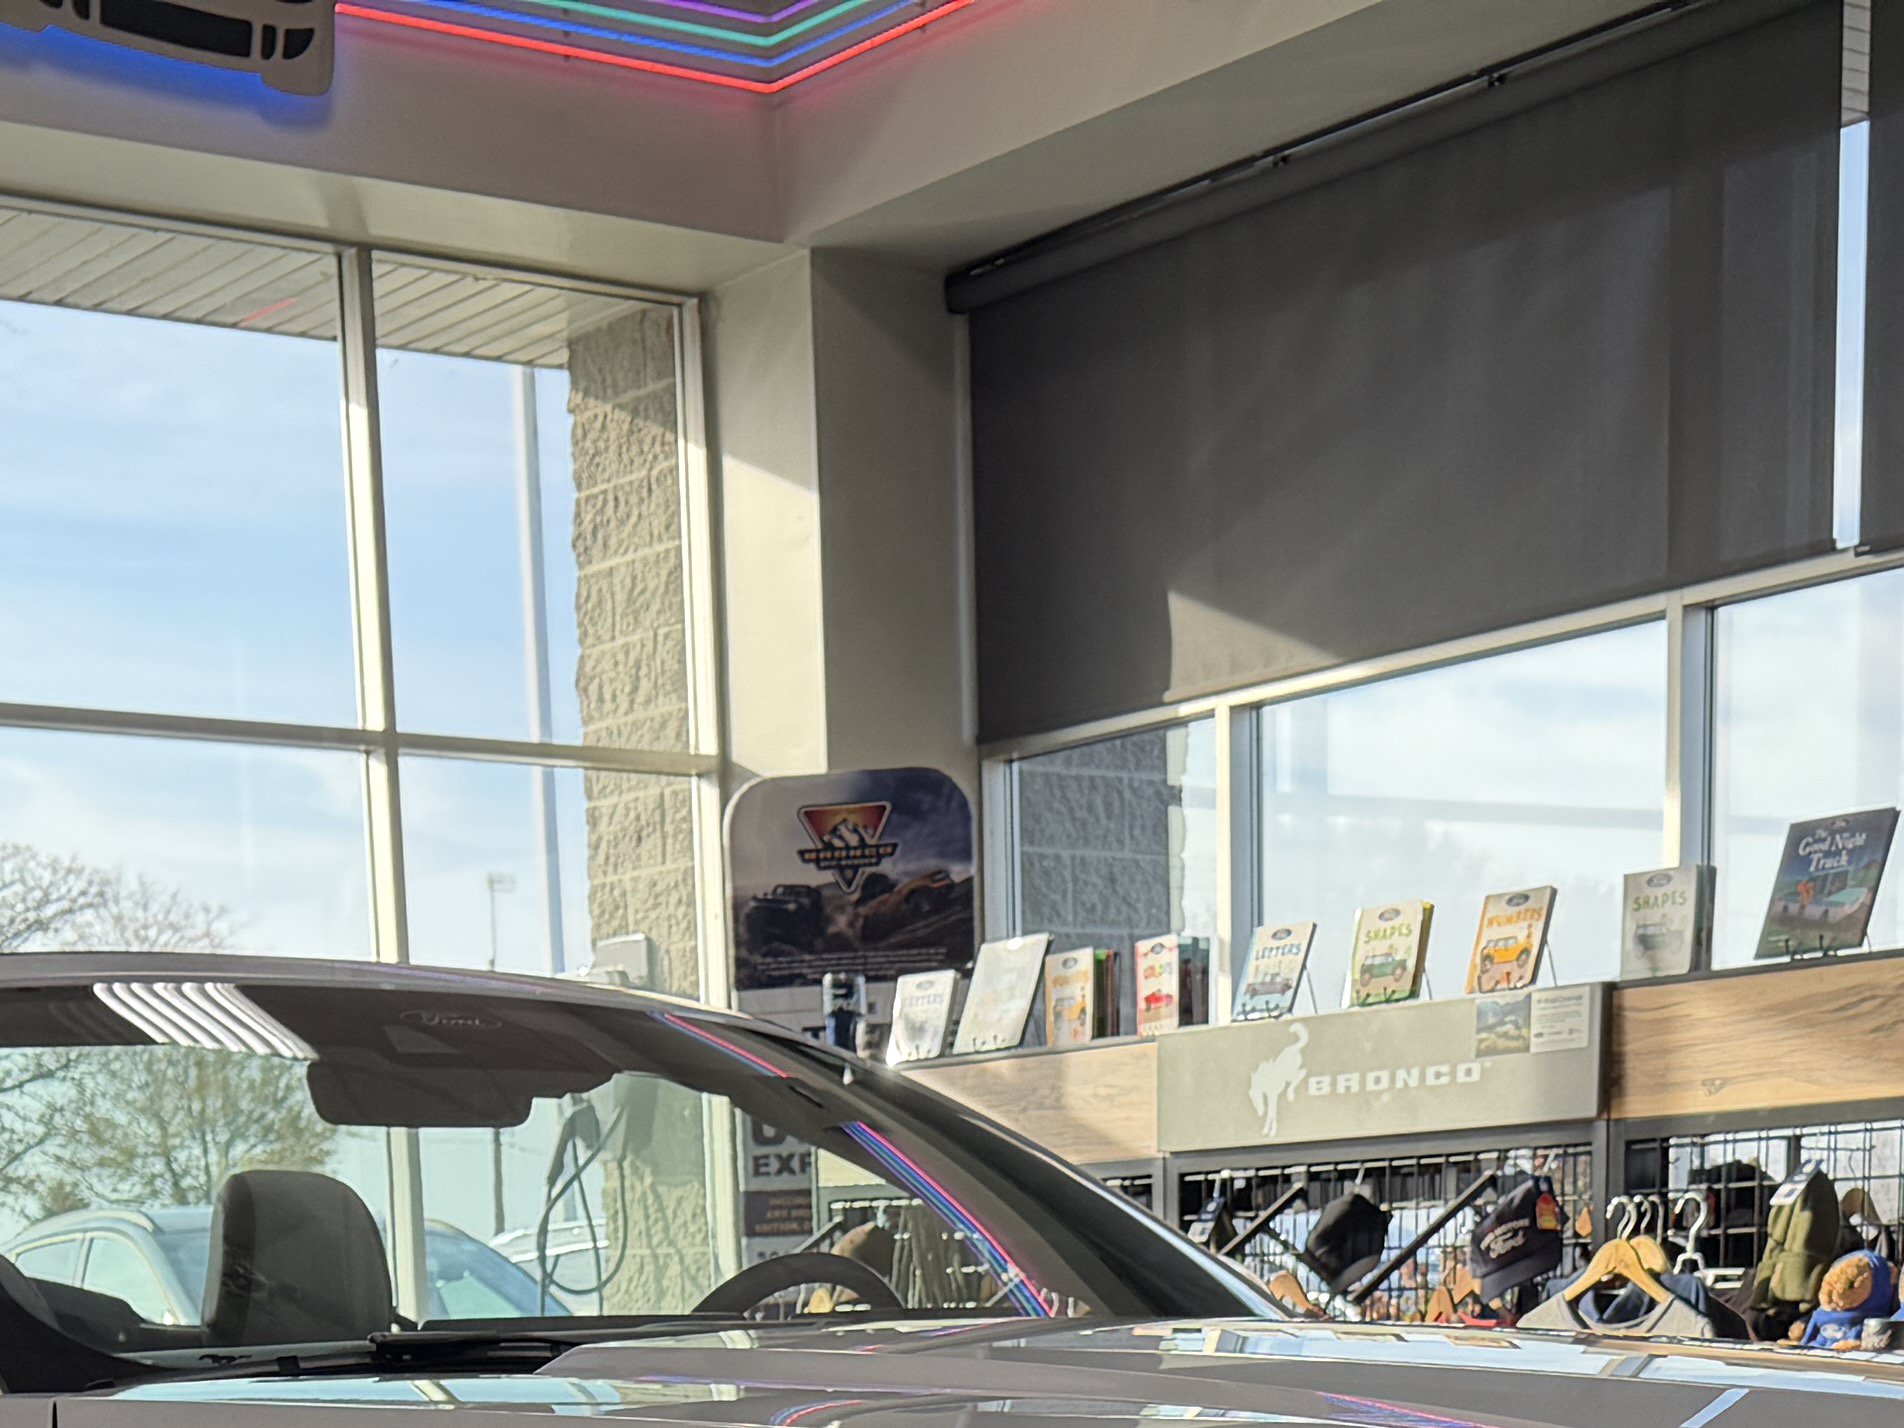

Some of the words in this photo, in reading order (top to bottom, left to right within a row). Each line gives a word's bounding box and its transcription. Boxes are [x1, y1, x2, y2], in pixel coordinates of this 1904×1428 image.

[1799, 835, 1831, 855] Good
[1832, 832, 1867, 852] Night
[1809, 852, 1849, 873] Truck
[1632, 890, 1688, 912] SHAPES
[1487, 907, 1543, 929] NUMBERS
[1364, 923, 1413, 945] SHAPES
[1255, 943, 1302, 961] LETTERS
[1308, 1062, 1482, 1096] BRONCO
